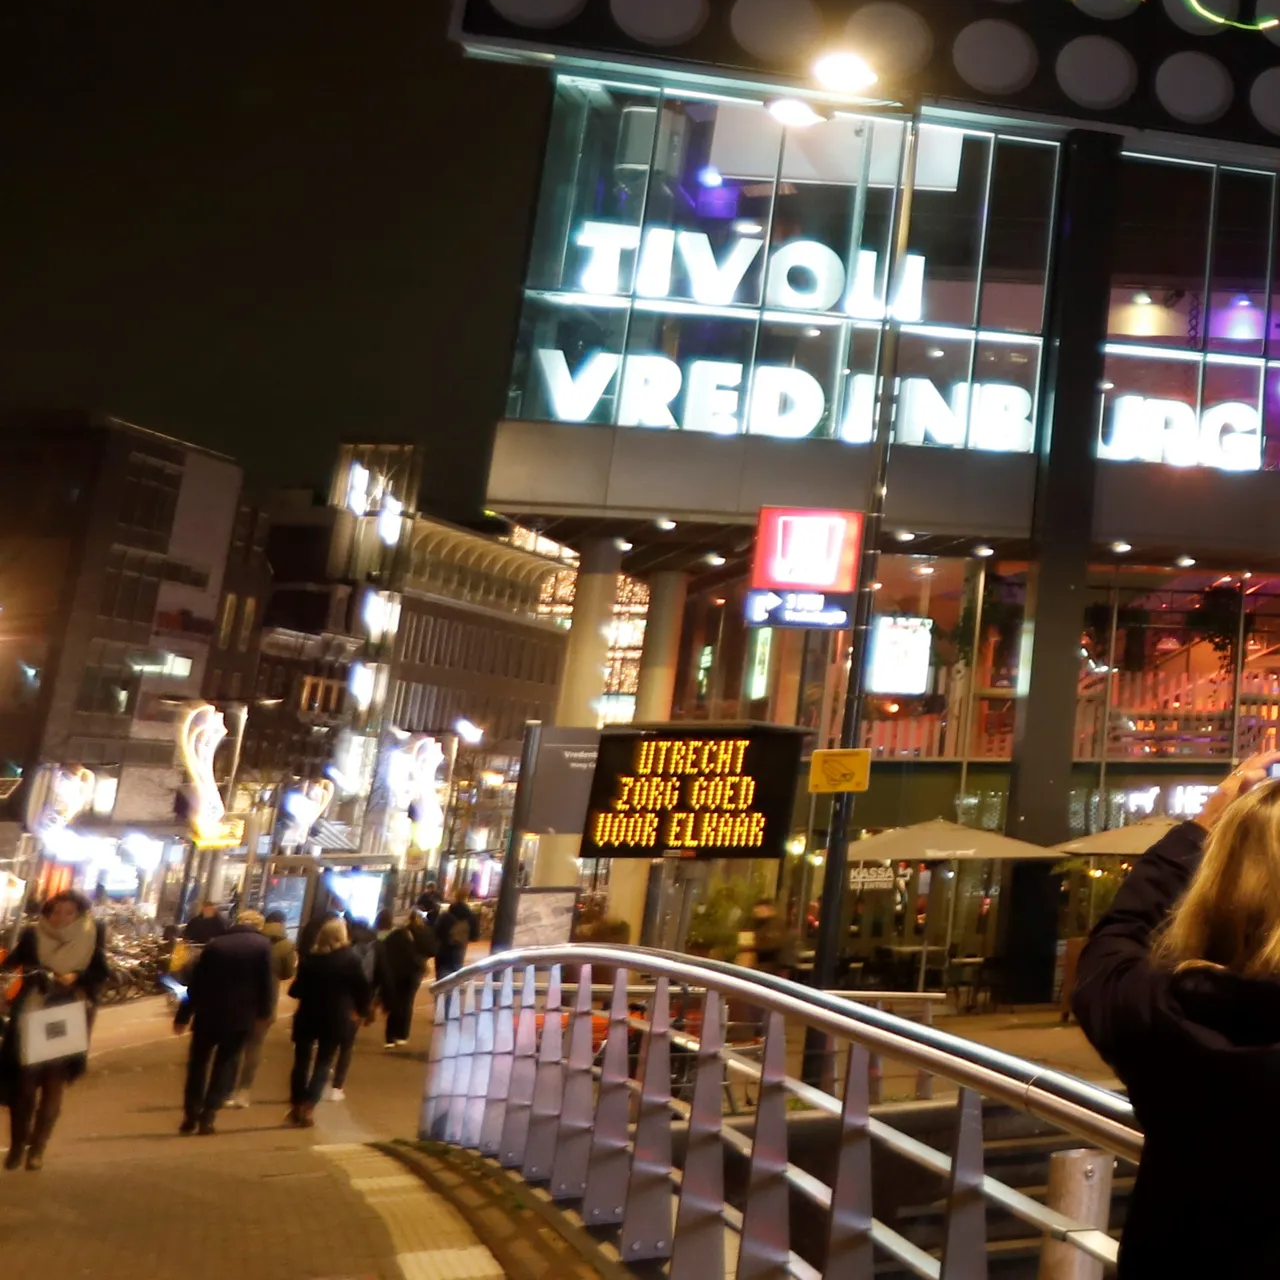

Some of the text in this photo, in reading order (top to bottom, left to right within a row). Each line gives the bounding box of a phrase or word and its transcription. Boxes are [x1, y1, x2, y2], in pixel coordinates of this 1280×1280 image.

[576, 220, 926, 322] TIVOLI
[637, 740, 750, 775] UTRECHT
[615, 776, 756, 811] ZORG GOED
[594, 812, 766, 848] VOOR ELKAAR
[850, 867, 894, 878] KASSA
